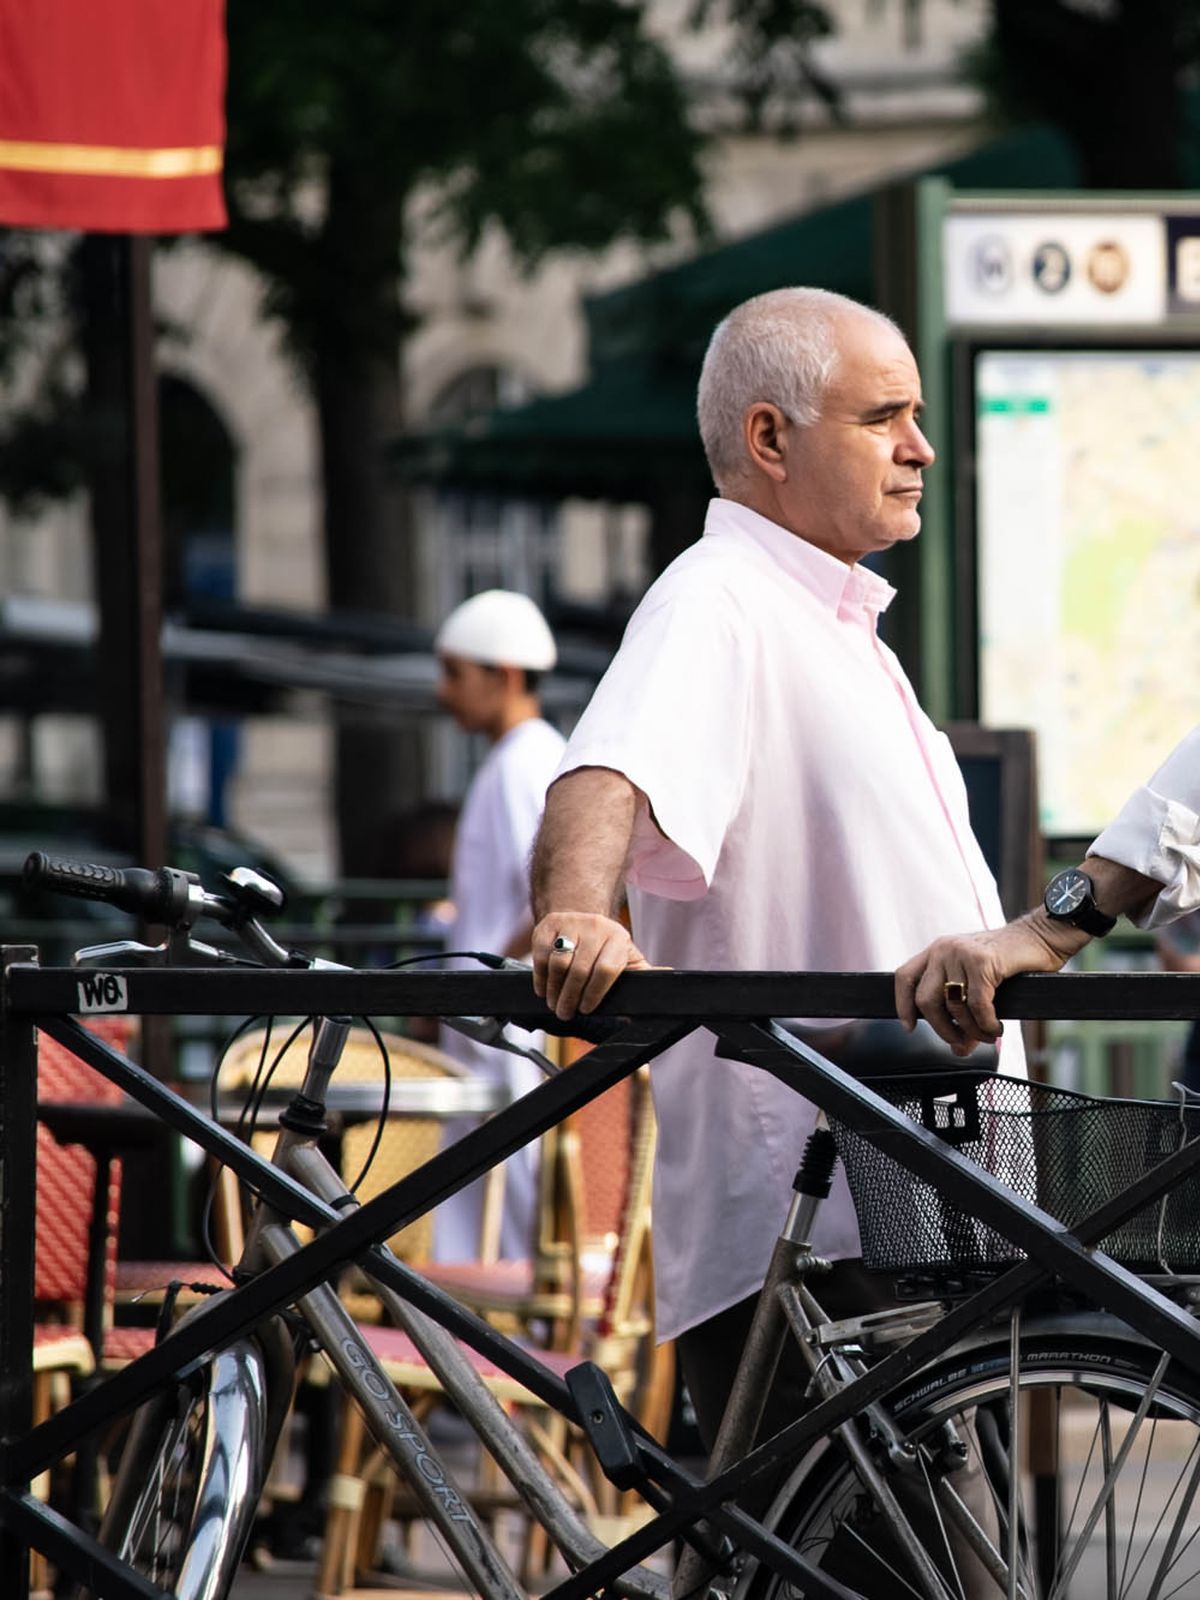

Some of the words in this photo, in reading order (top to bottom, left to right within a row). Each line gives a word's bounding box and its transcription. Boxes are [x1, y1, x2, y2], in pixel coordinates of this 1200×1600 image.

[1027, 1351, 1111, 1364] MARATHON
[894, 1368, 967, 1412] SCHWALBE
[343, 1338, 390, 1400] GO
[386, 1411, 479, 1530] SPORT
